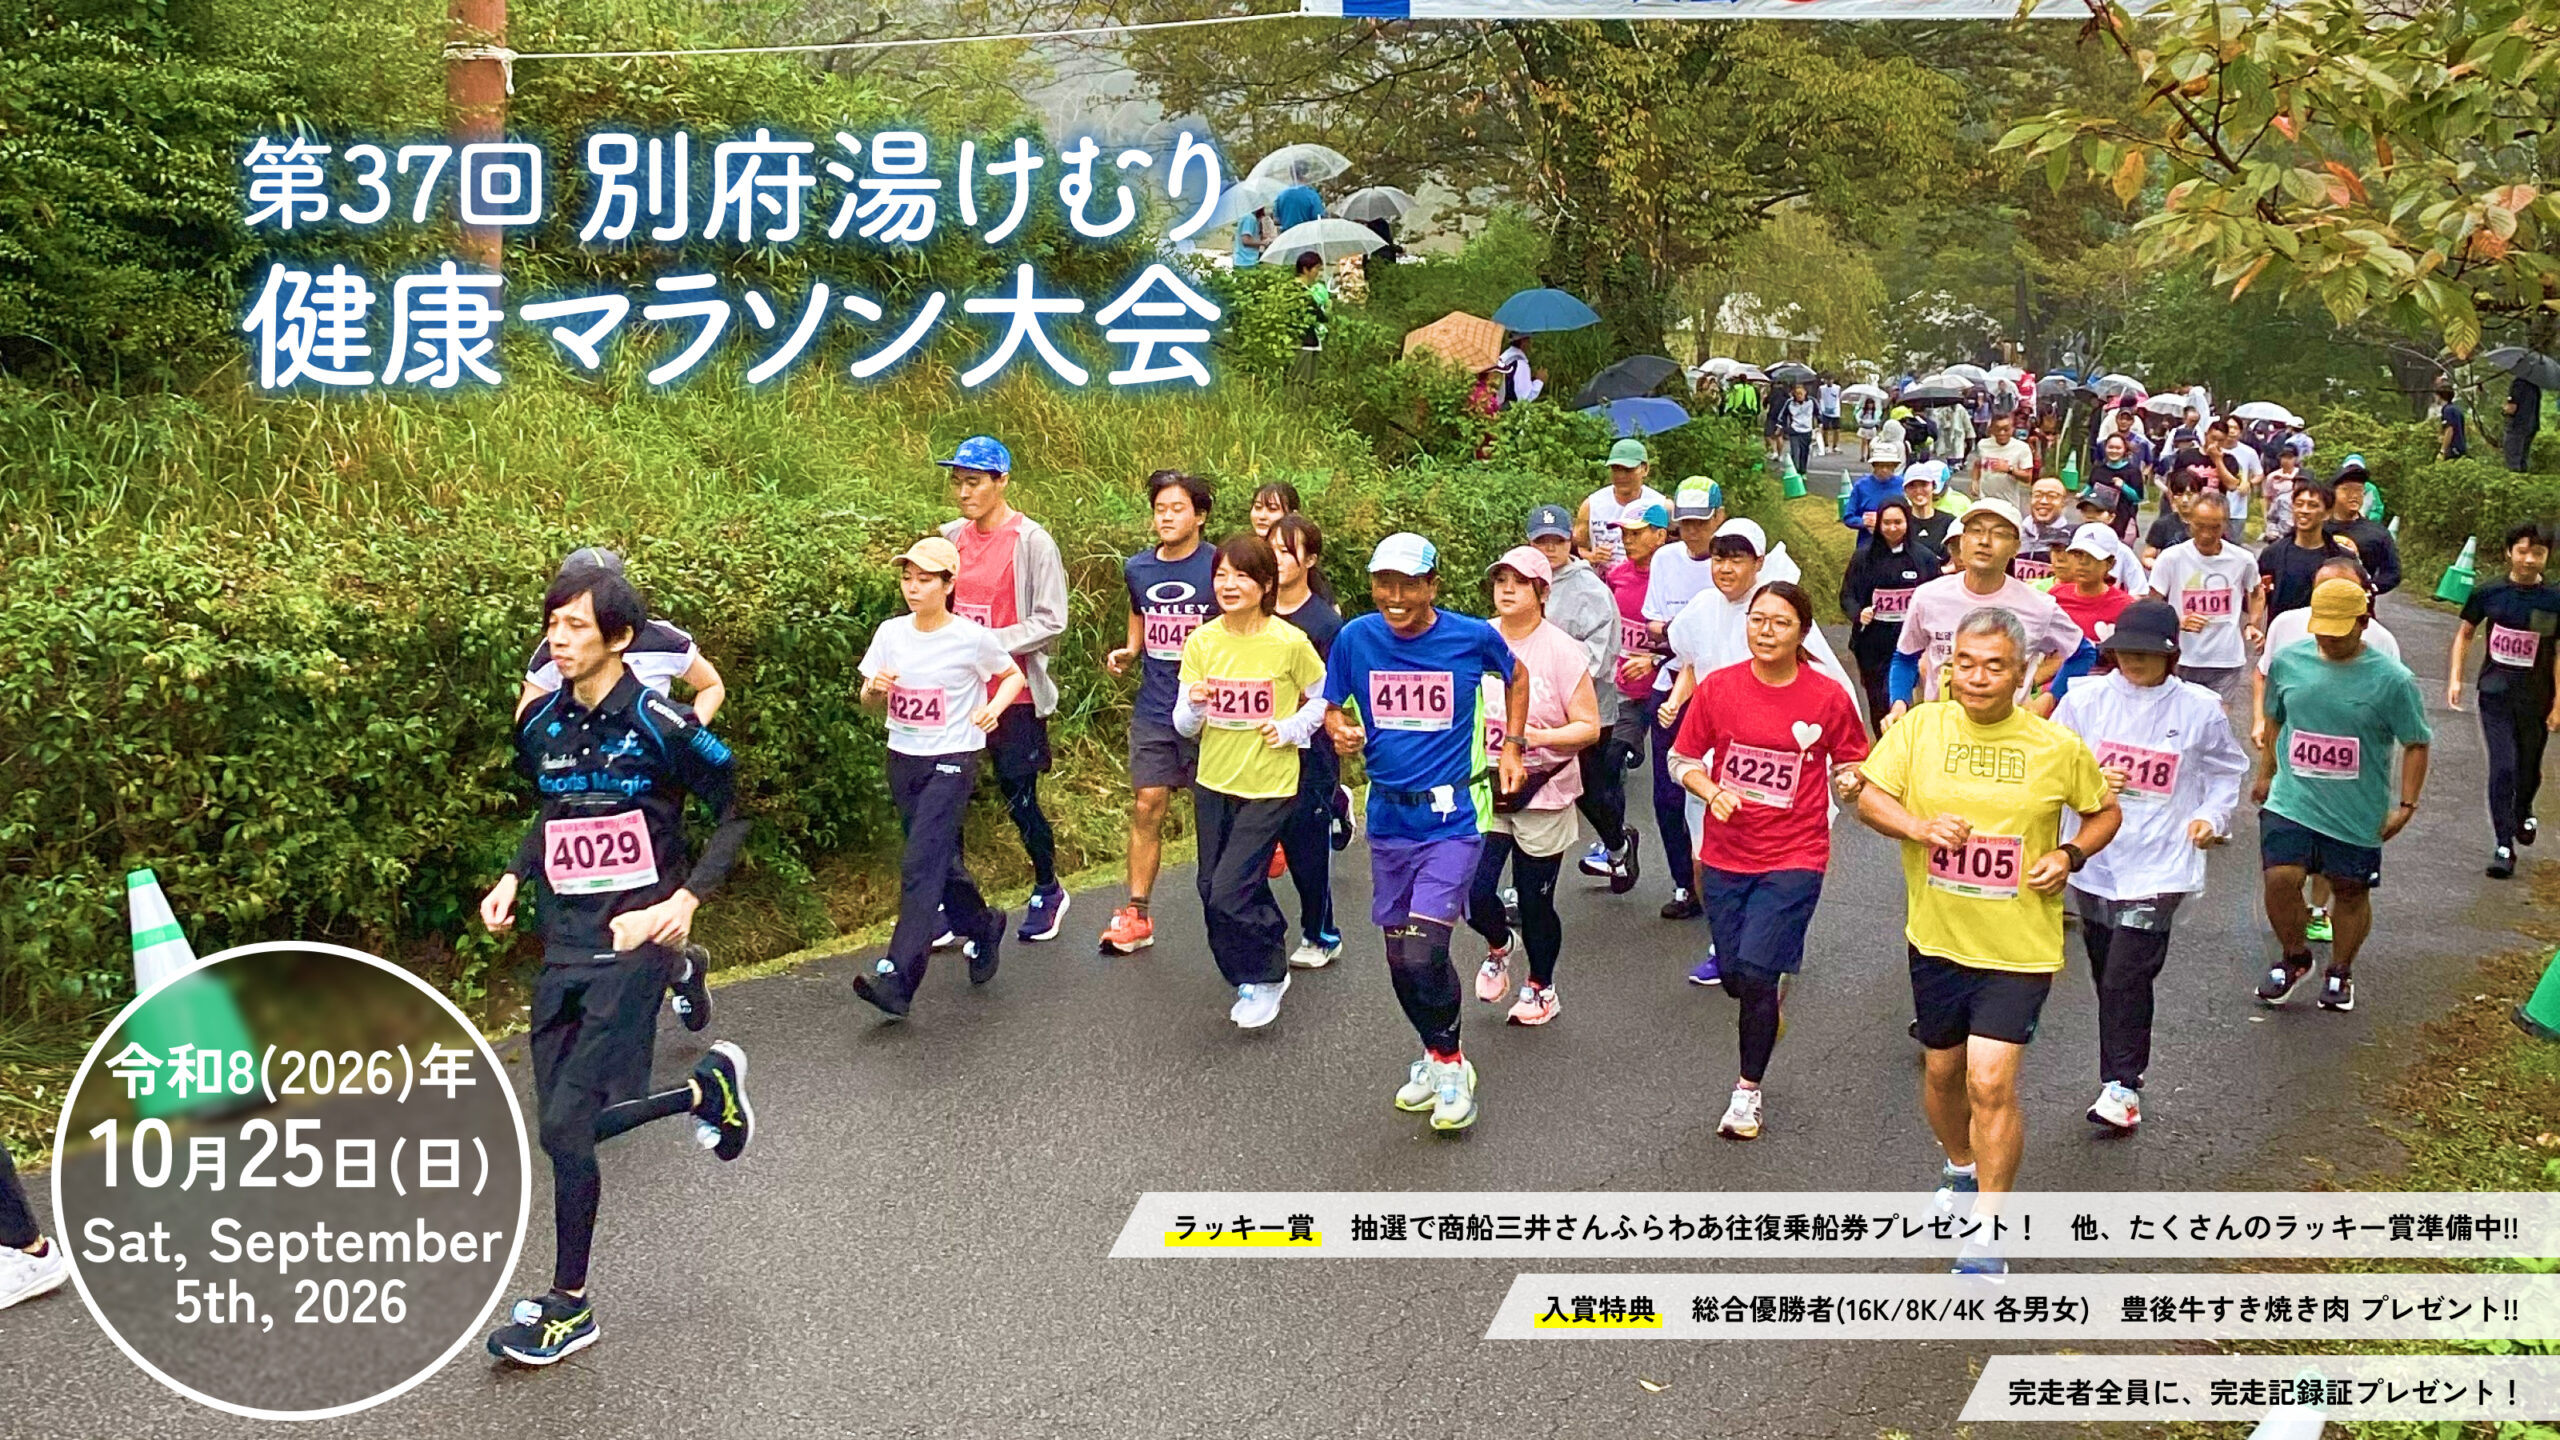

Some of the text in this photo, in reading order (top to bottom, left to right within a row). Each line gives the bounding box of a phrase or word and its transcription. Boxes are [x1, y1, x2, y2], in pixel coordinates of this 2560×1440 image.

[1141, 604, 1210, 615] AKLEY
[2186, 595, 2230, 612] 4101
[890, 692, 941, 720] 4224
[1210, 688, 1270, 714] 4216
[1376, 684, 1446, 712] 4116
[1944, 743, 2026, 779] run
[2293, 741, 2354, 768] 4049
[1725, 755, 1794, 792] 4225
[552, 830, 642, 871] 4029
[1932, 844, 2015, 879] 4105
